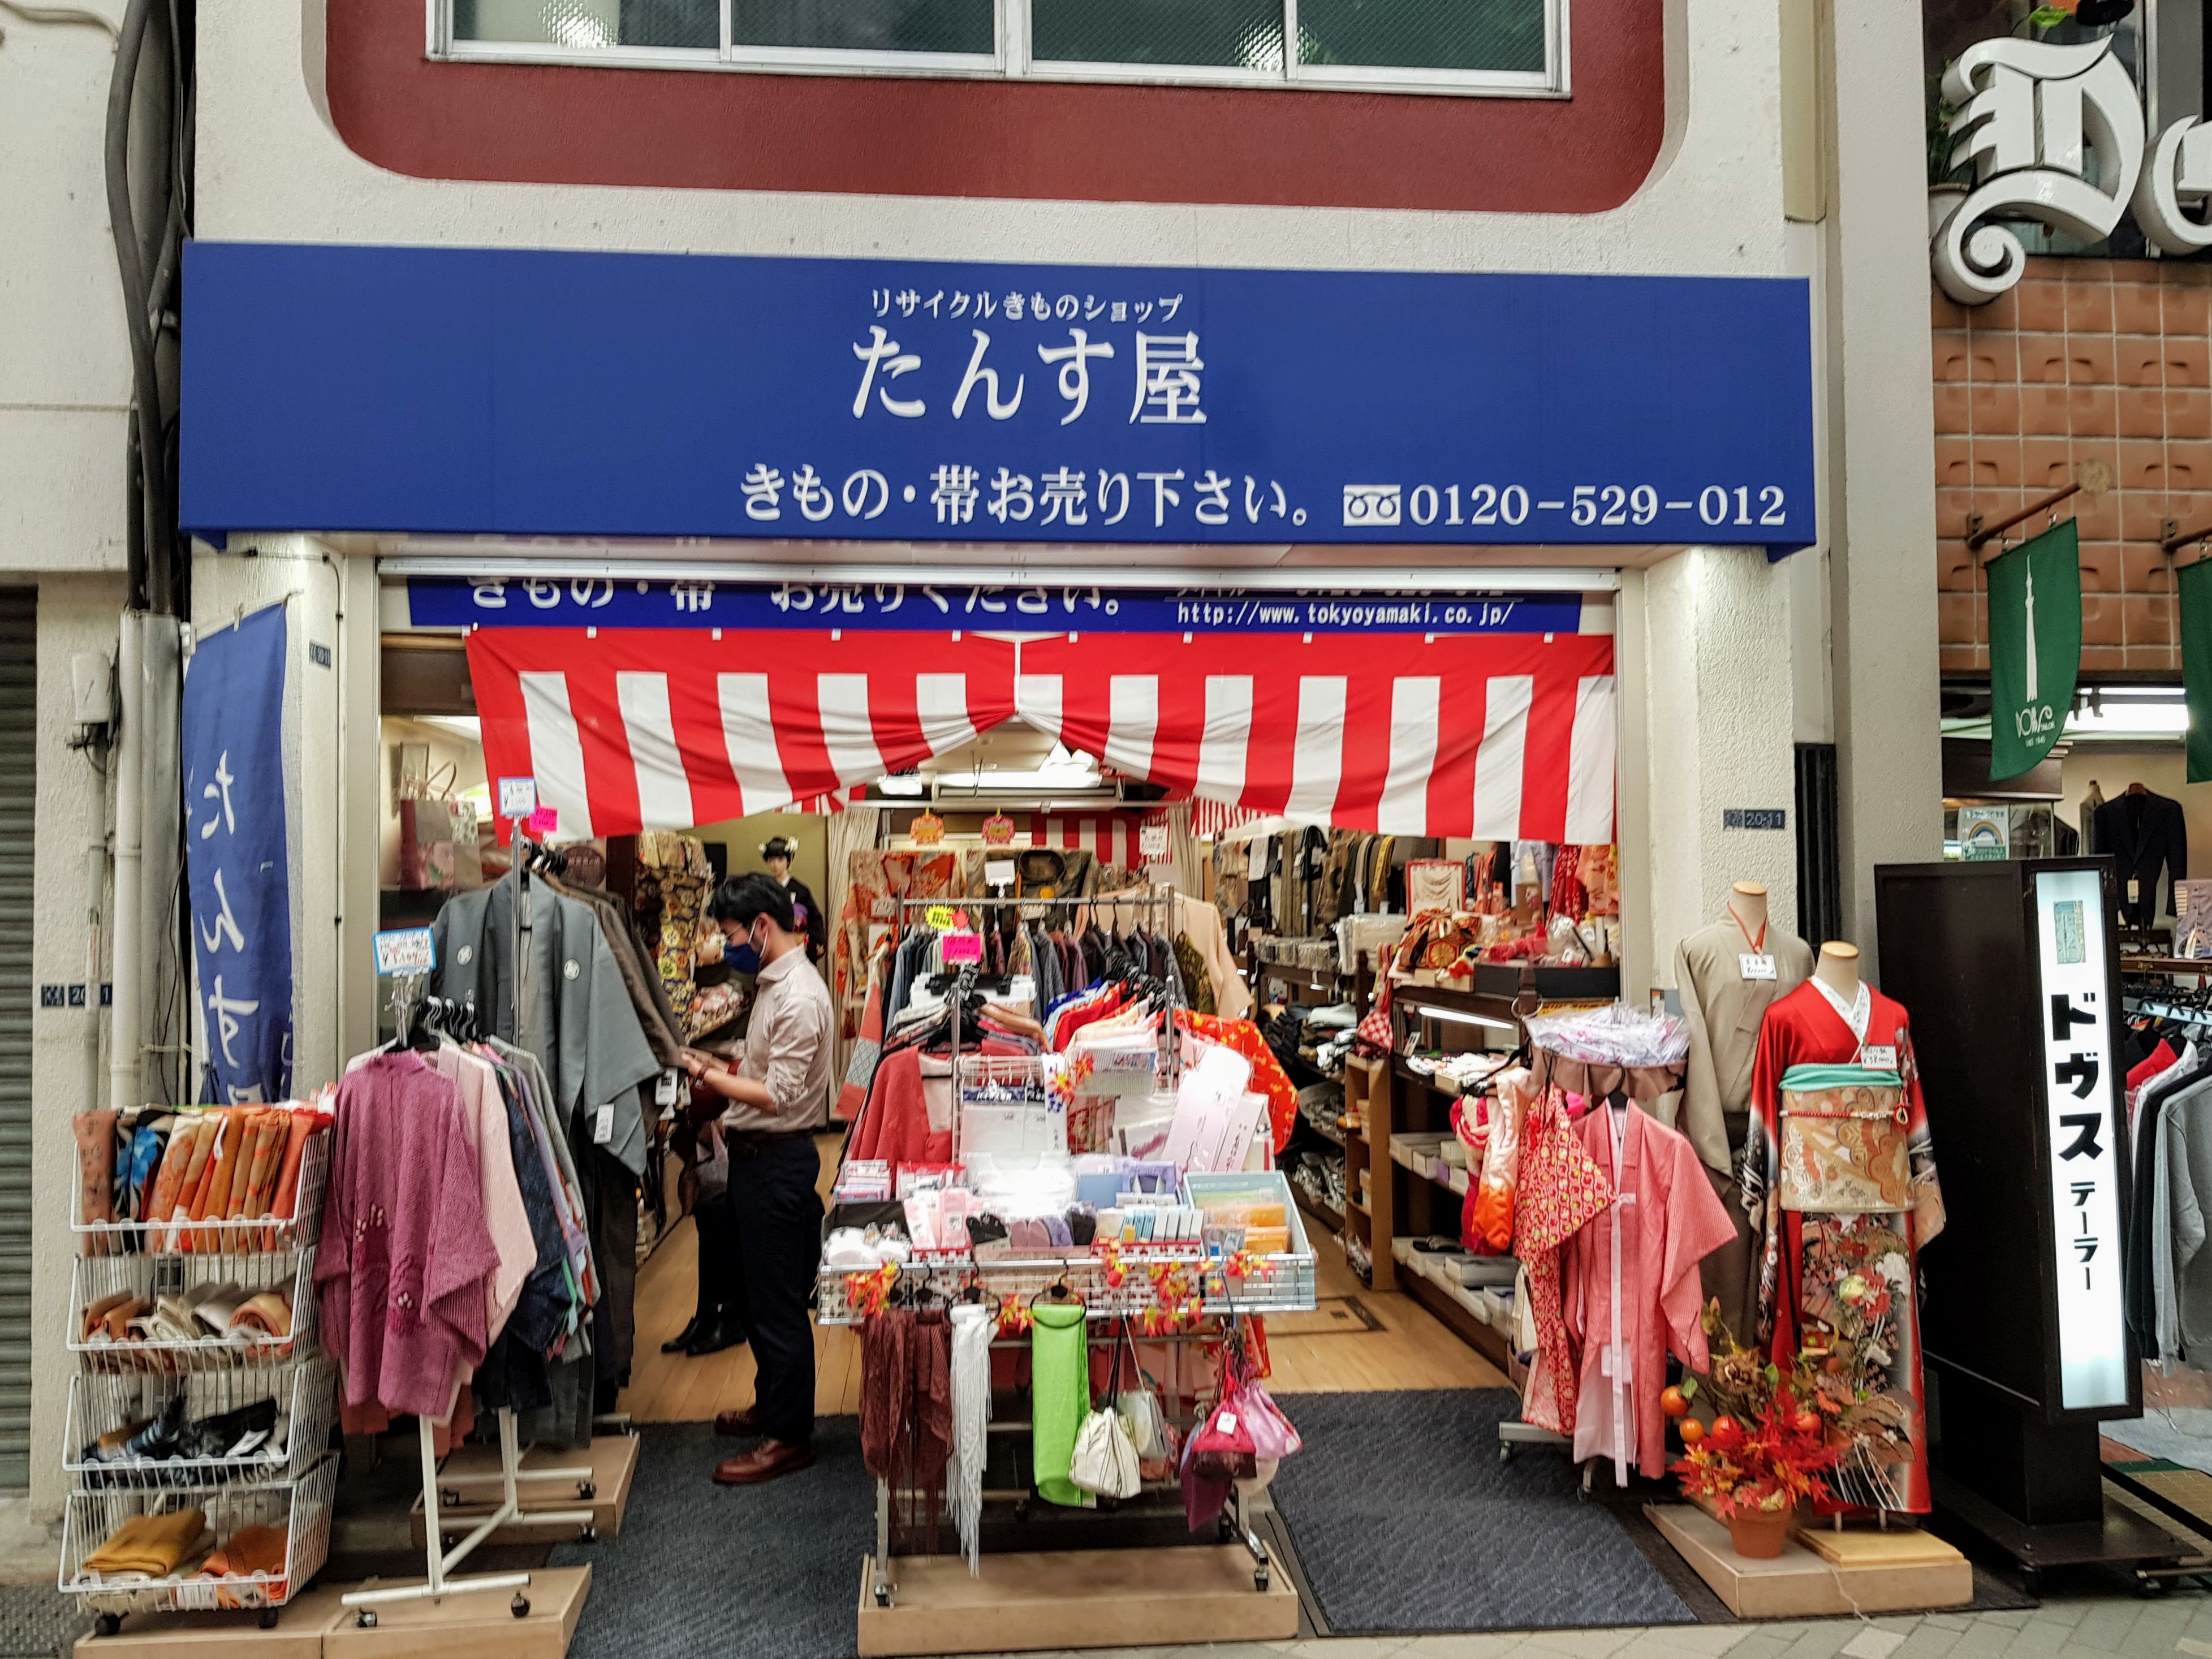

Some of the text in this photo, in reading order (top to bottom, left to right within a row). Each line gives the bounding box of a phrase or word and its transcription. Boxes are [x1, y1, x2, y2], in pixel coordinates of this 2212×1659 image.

[871, 287, 1184, 324] リサイクルきものショップ
[852, 324, 1208, 426] たんす屋
[2051, 992, 2104, 1290] ドヴス テーラー
